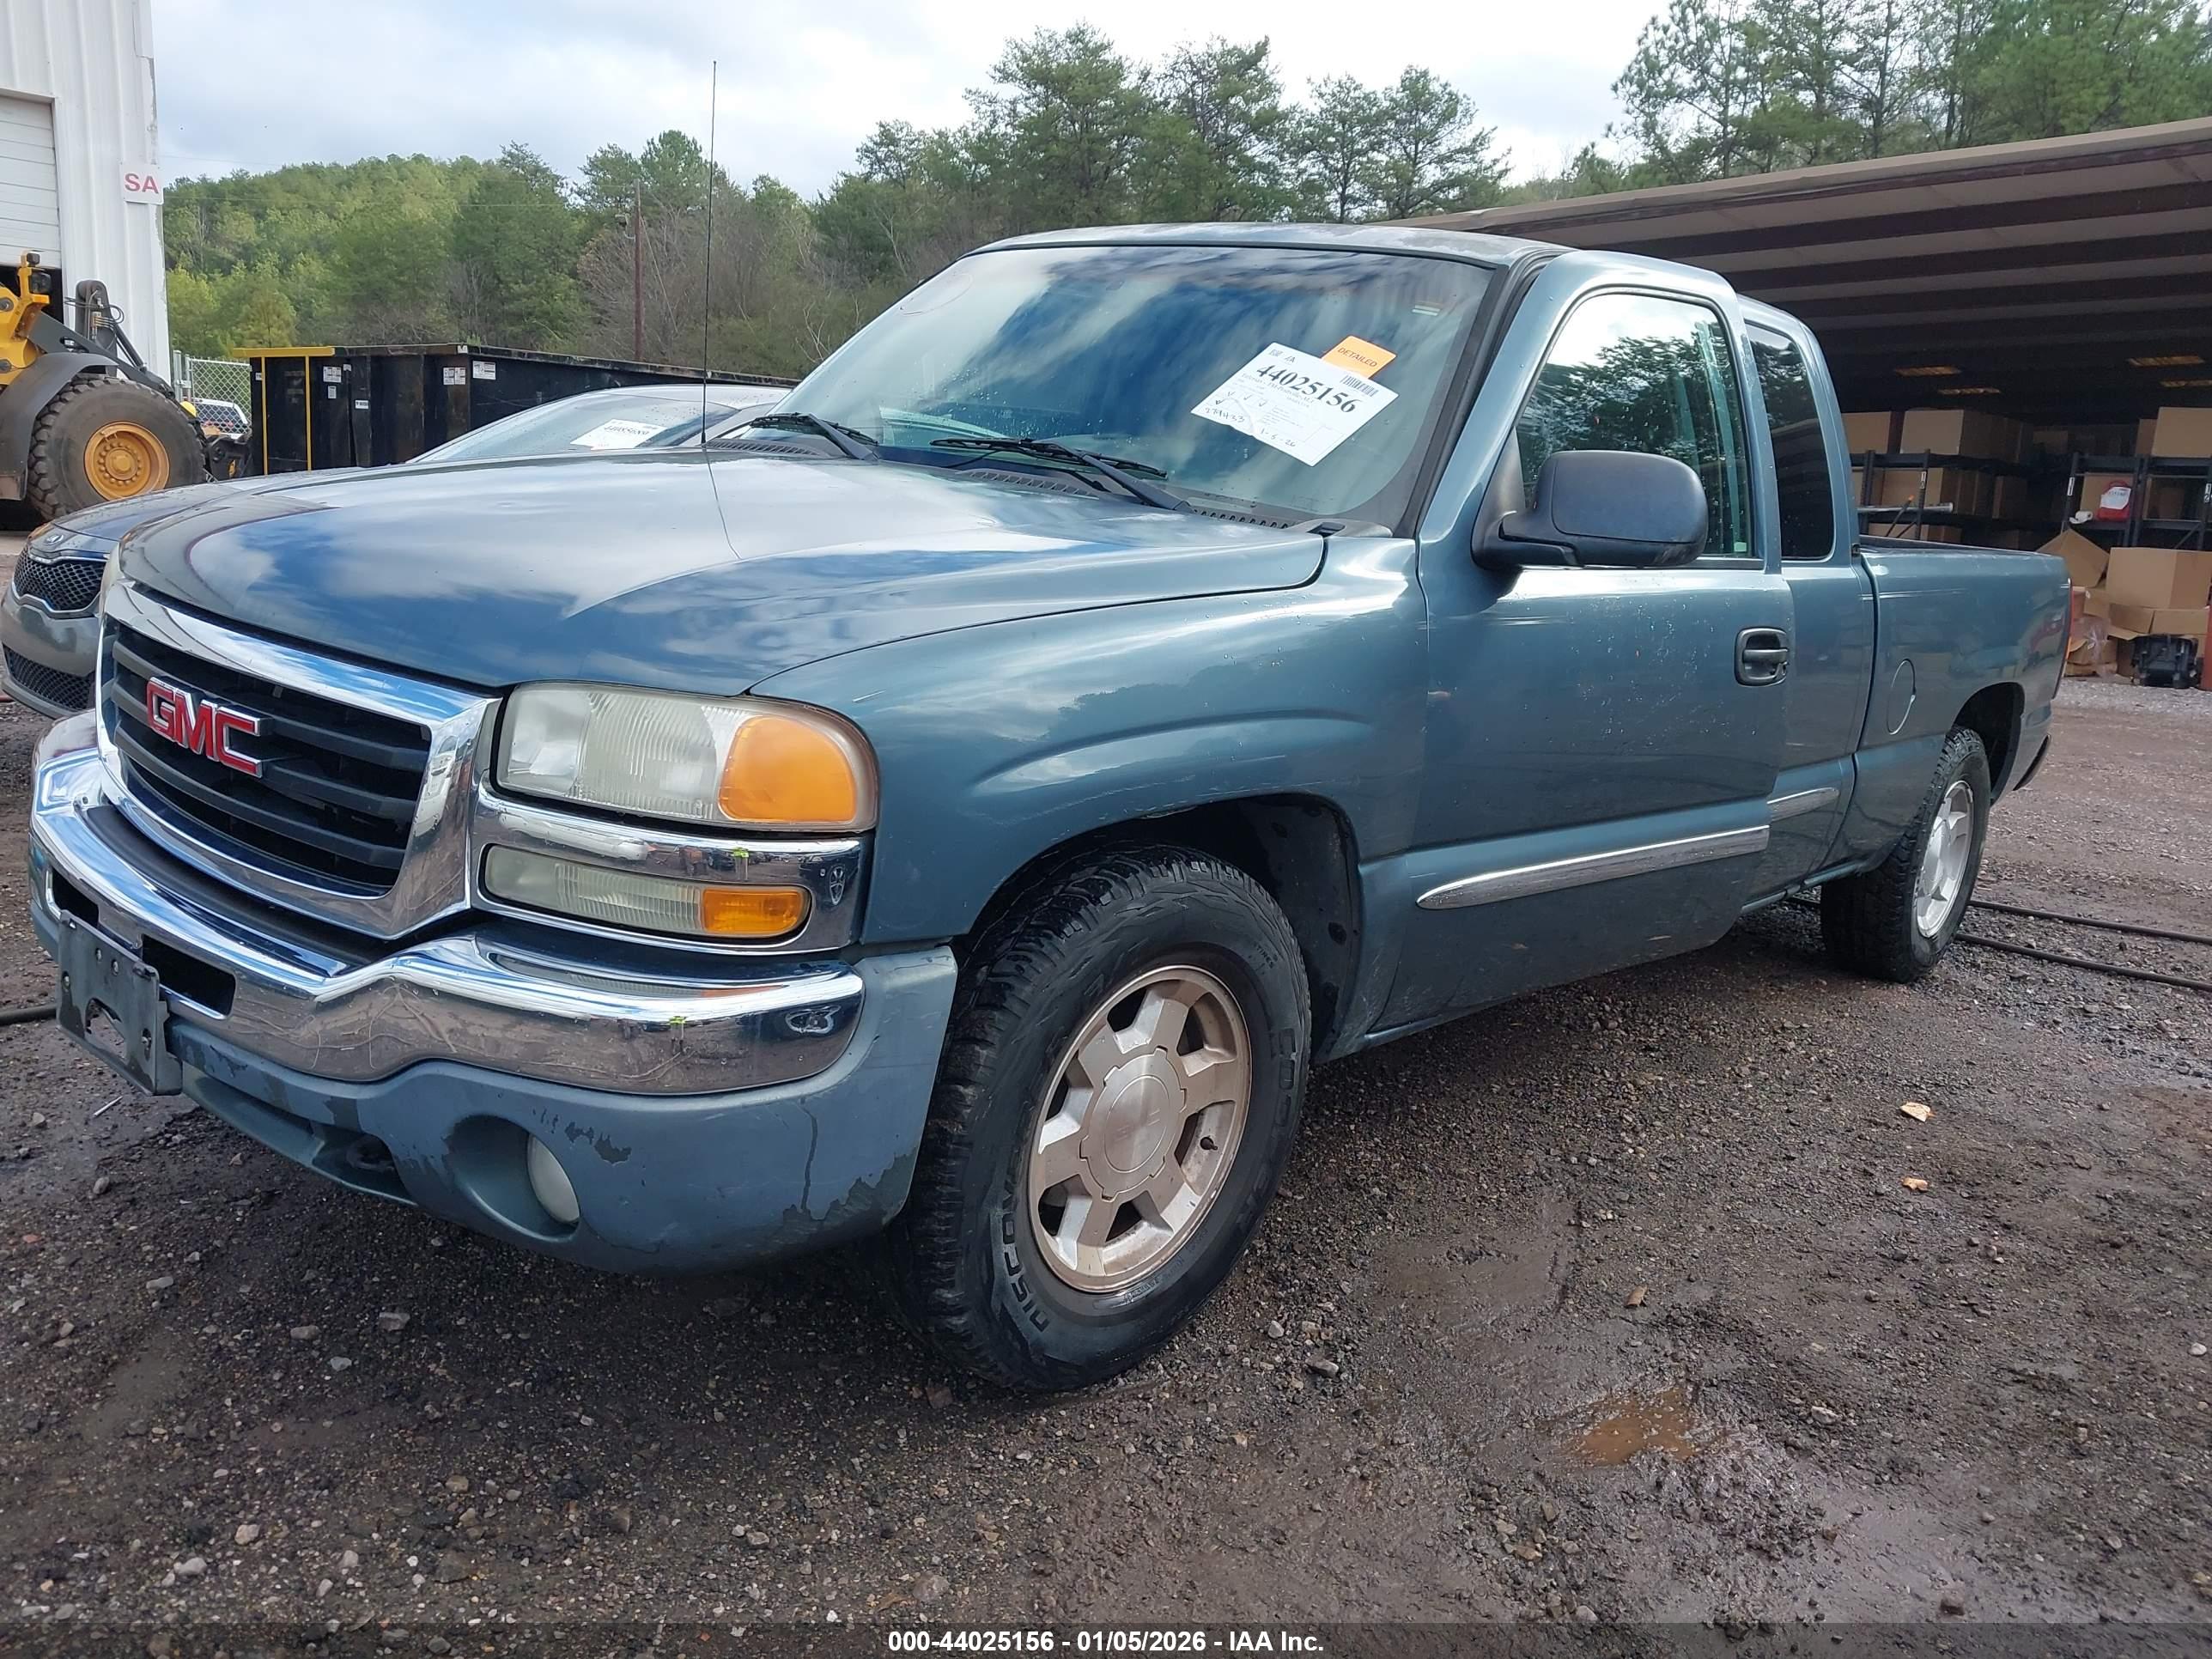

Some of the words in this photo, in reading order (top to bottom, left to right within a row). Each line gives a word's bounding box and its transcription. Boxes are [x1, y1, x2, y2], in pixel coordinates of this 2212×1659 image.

[125, 173, 159, 194] SA
[1338, 347, 1377, 368] DETAILED
[1256, 364, 1361, 413] 44025156
[147, 677, 263, 779] GMC
